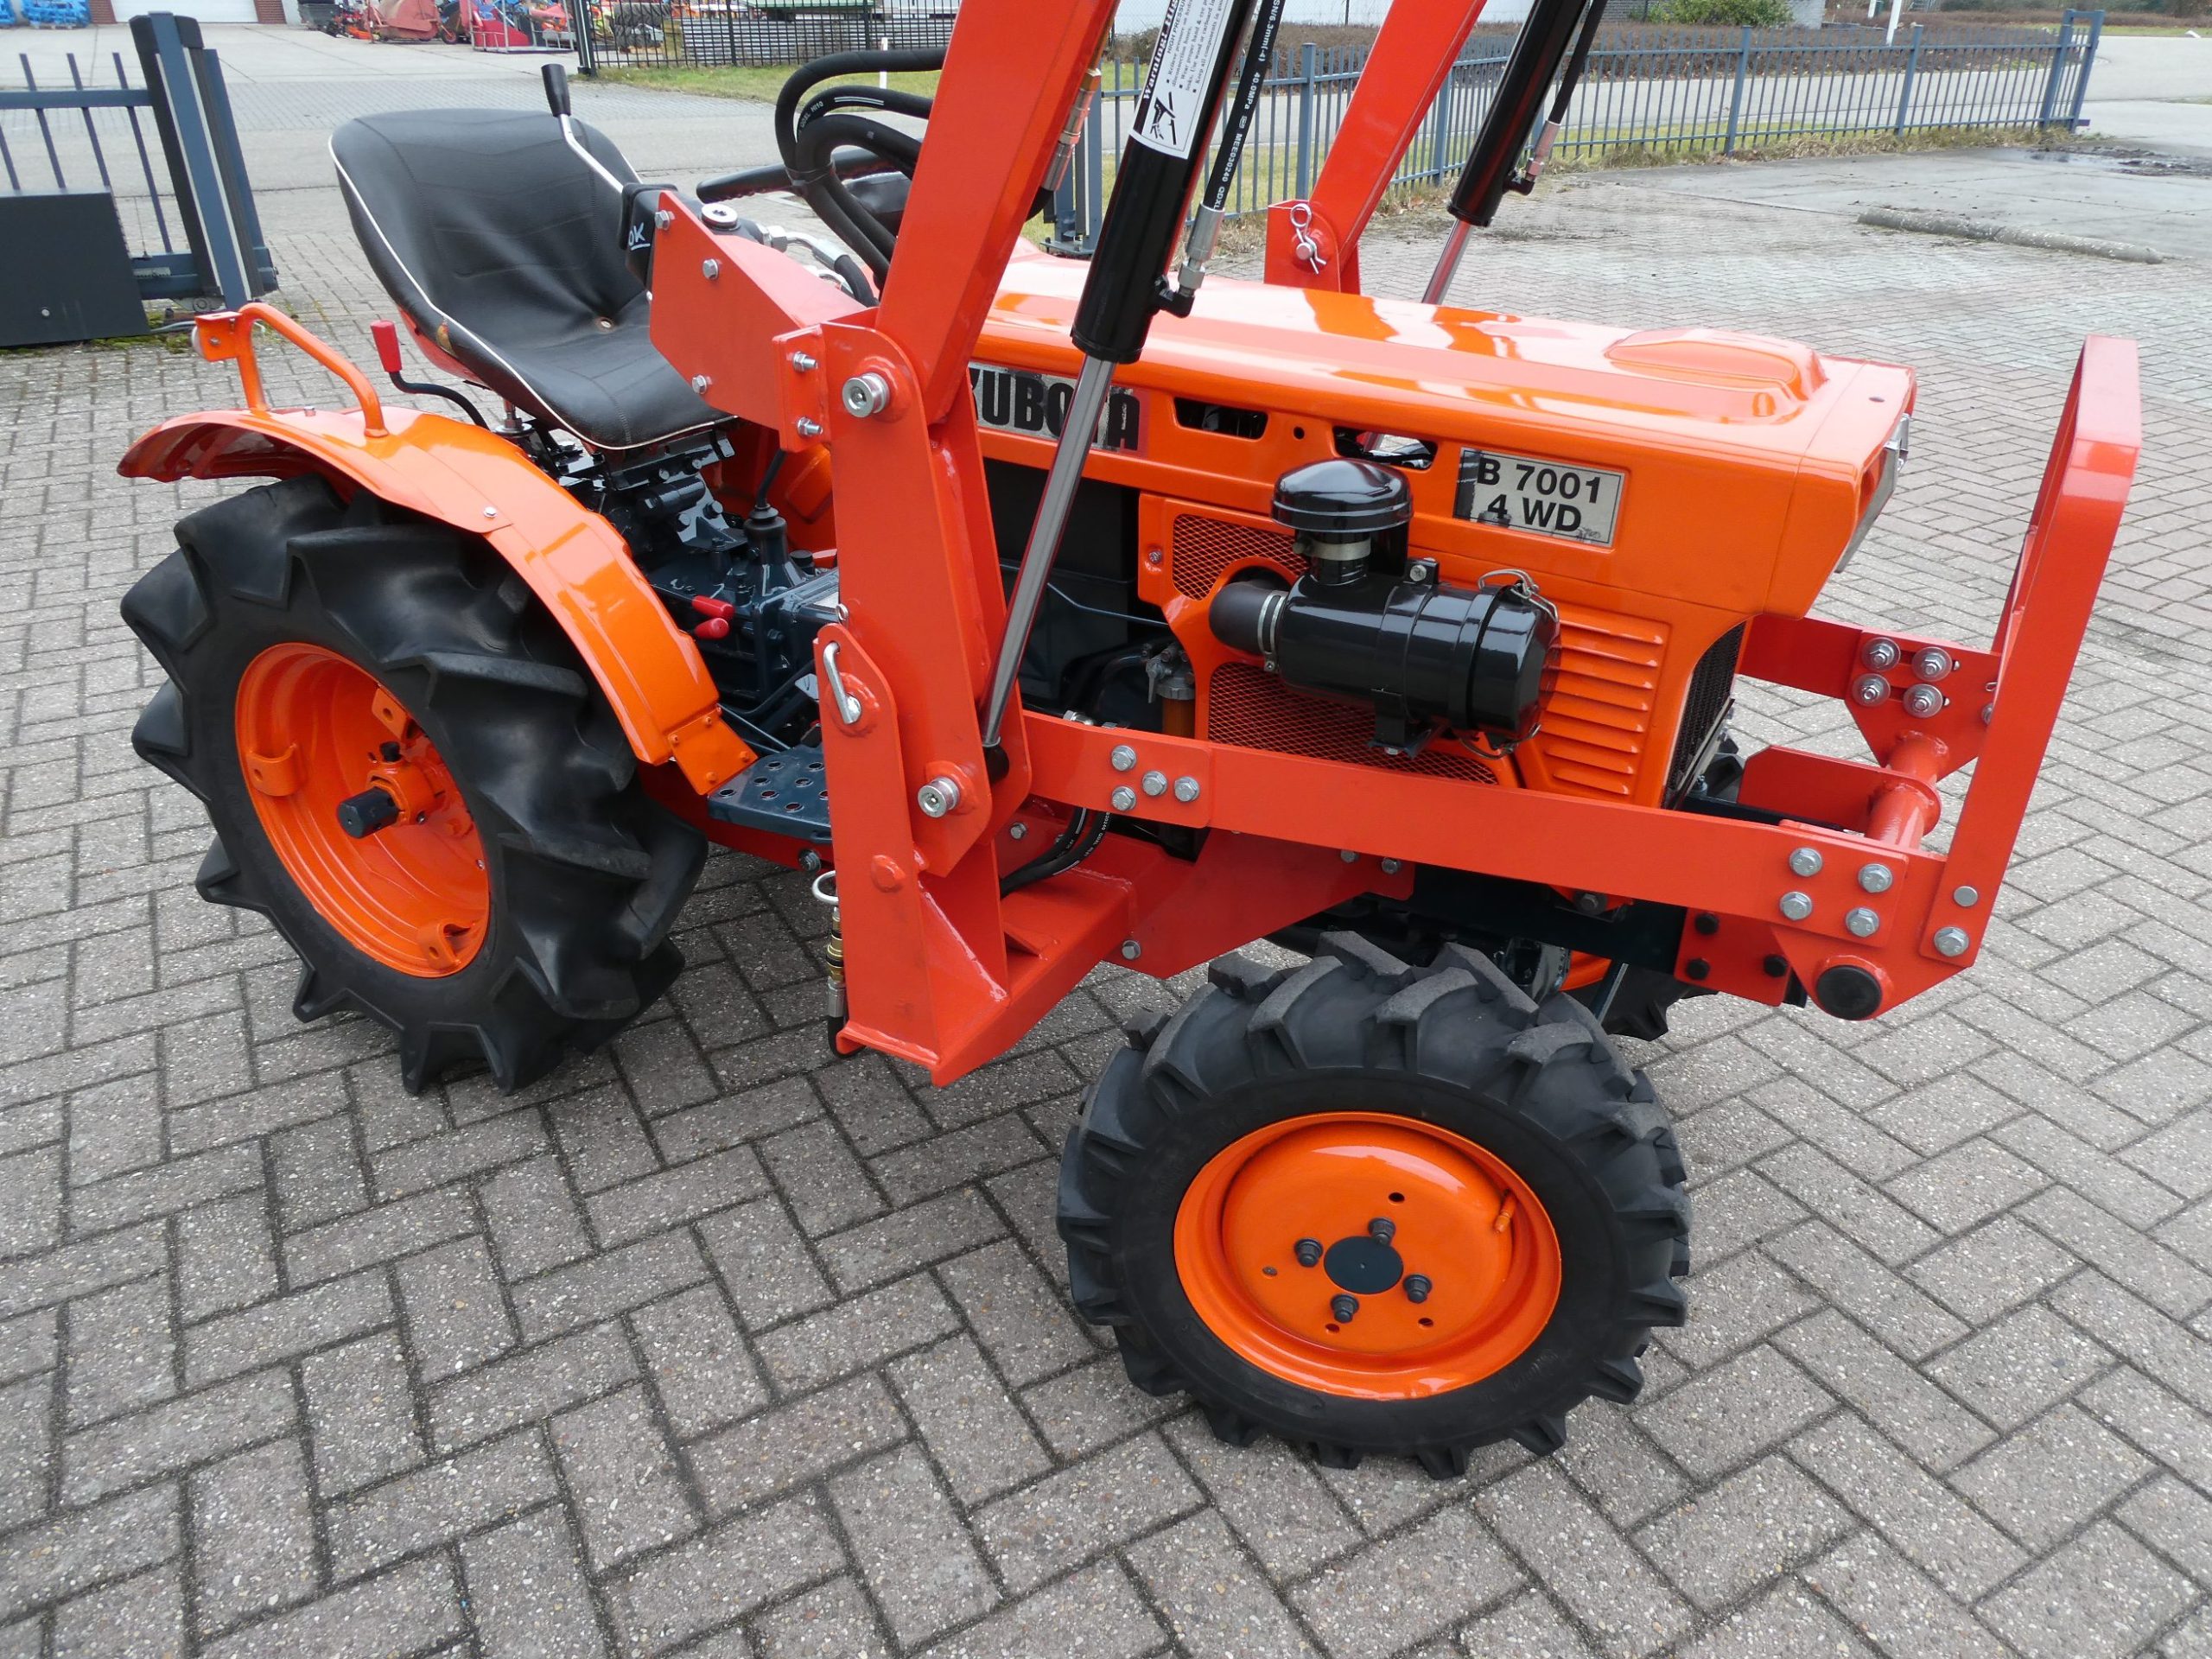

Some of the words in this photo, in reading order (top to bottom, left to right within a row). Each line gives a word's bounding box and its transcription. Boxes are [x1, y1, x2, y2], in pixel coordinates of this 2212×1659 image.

[1142, 32, 1167, 99] Warning!
[1167, 35, 1176, 53] HIGH
[628, 222, 645, 247] OK
[969, 366, 1141, 451] UBOA
[1477, 456, 1501, 486] B
[1516, 464, 1601, 504] 7001
[1487, 493, 1508, 519] 4
[1522, 497, 1582, 532] WD
